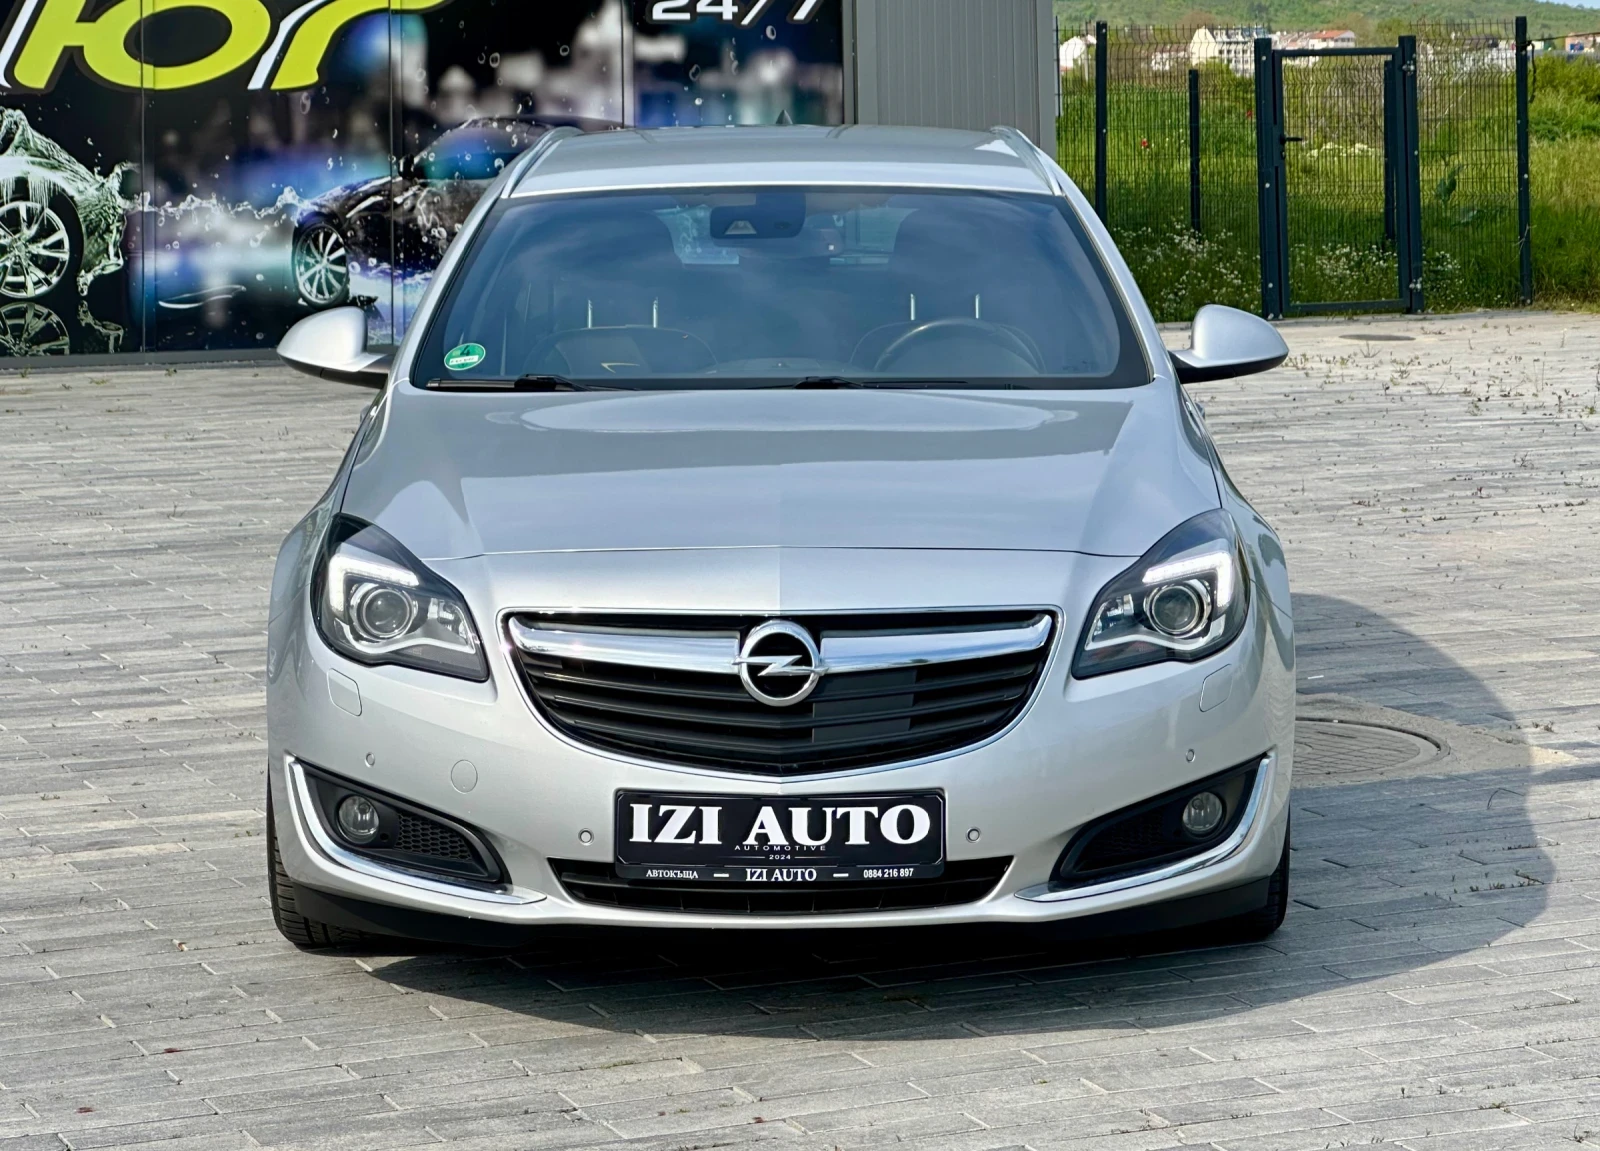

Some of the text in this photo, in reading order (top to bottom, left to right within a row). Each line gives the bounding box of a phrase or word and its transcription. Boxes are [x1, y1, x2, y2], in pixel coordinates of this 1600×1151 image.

[629, 803, 930, 845] IZI AUTO
[646, 868, 914, 881] АВТОКЪЩА IZI AUTO 0884 216 897
